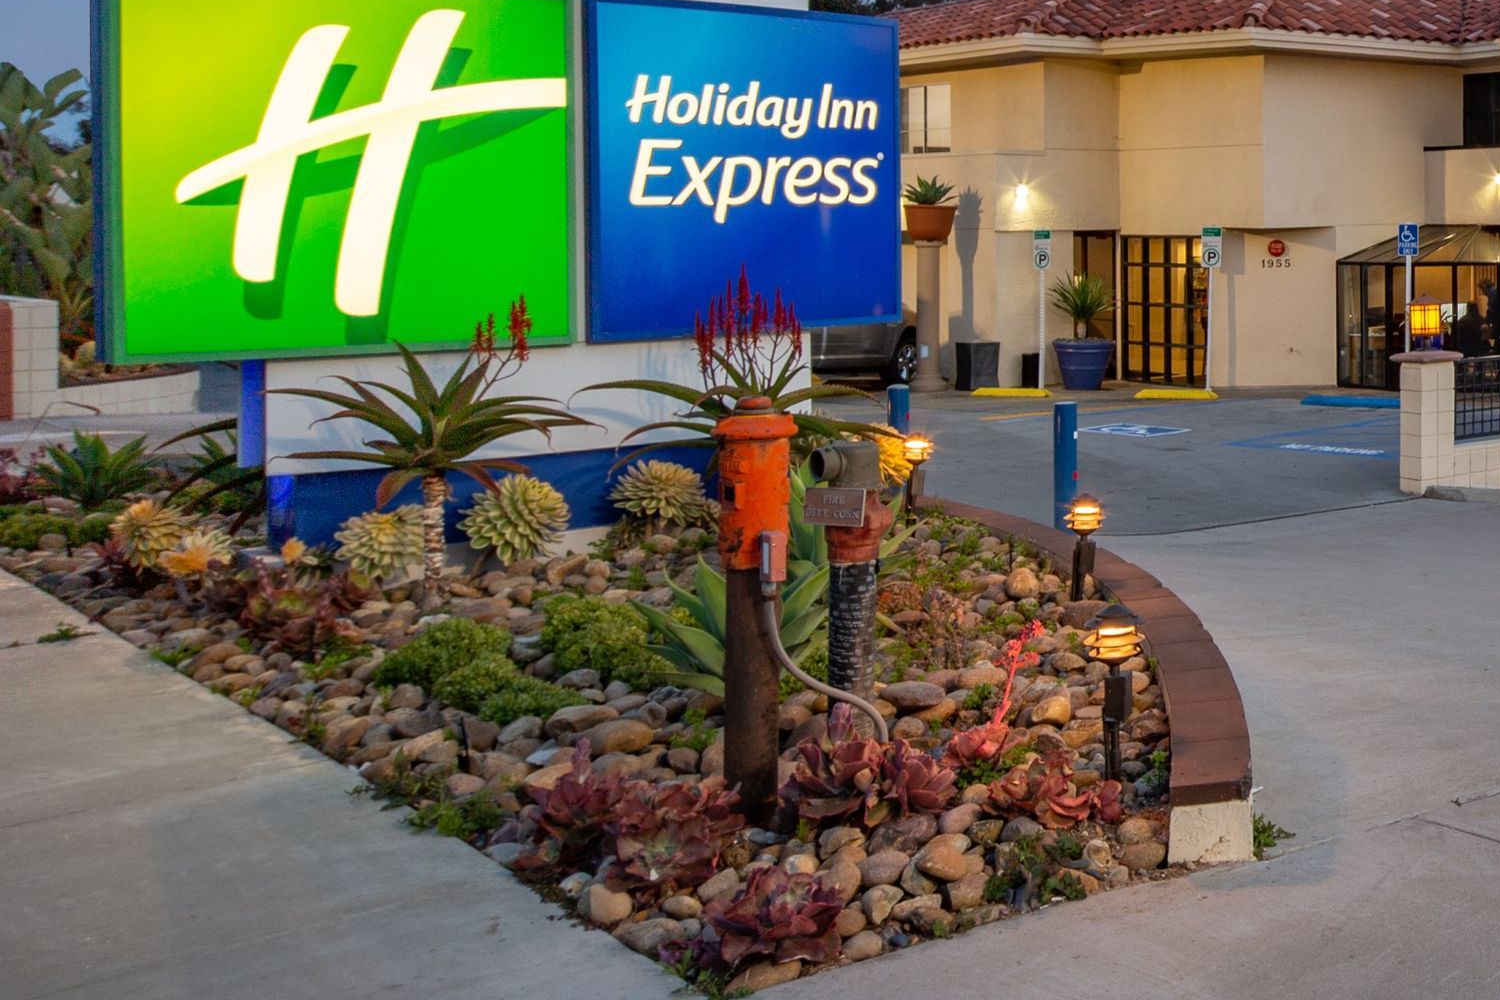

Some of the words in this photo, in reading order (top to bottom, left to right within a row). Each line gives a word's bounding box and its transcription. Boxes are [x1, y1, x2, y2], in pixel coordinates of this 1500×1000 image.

[625, 74, 813, 139] Holiday
[817, 83, 878, 131] Inn
[629, 139, 880, 224] Express
[1261, 258, 1291, 269] 1955
[823, 495, 846, 504] FIRE
